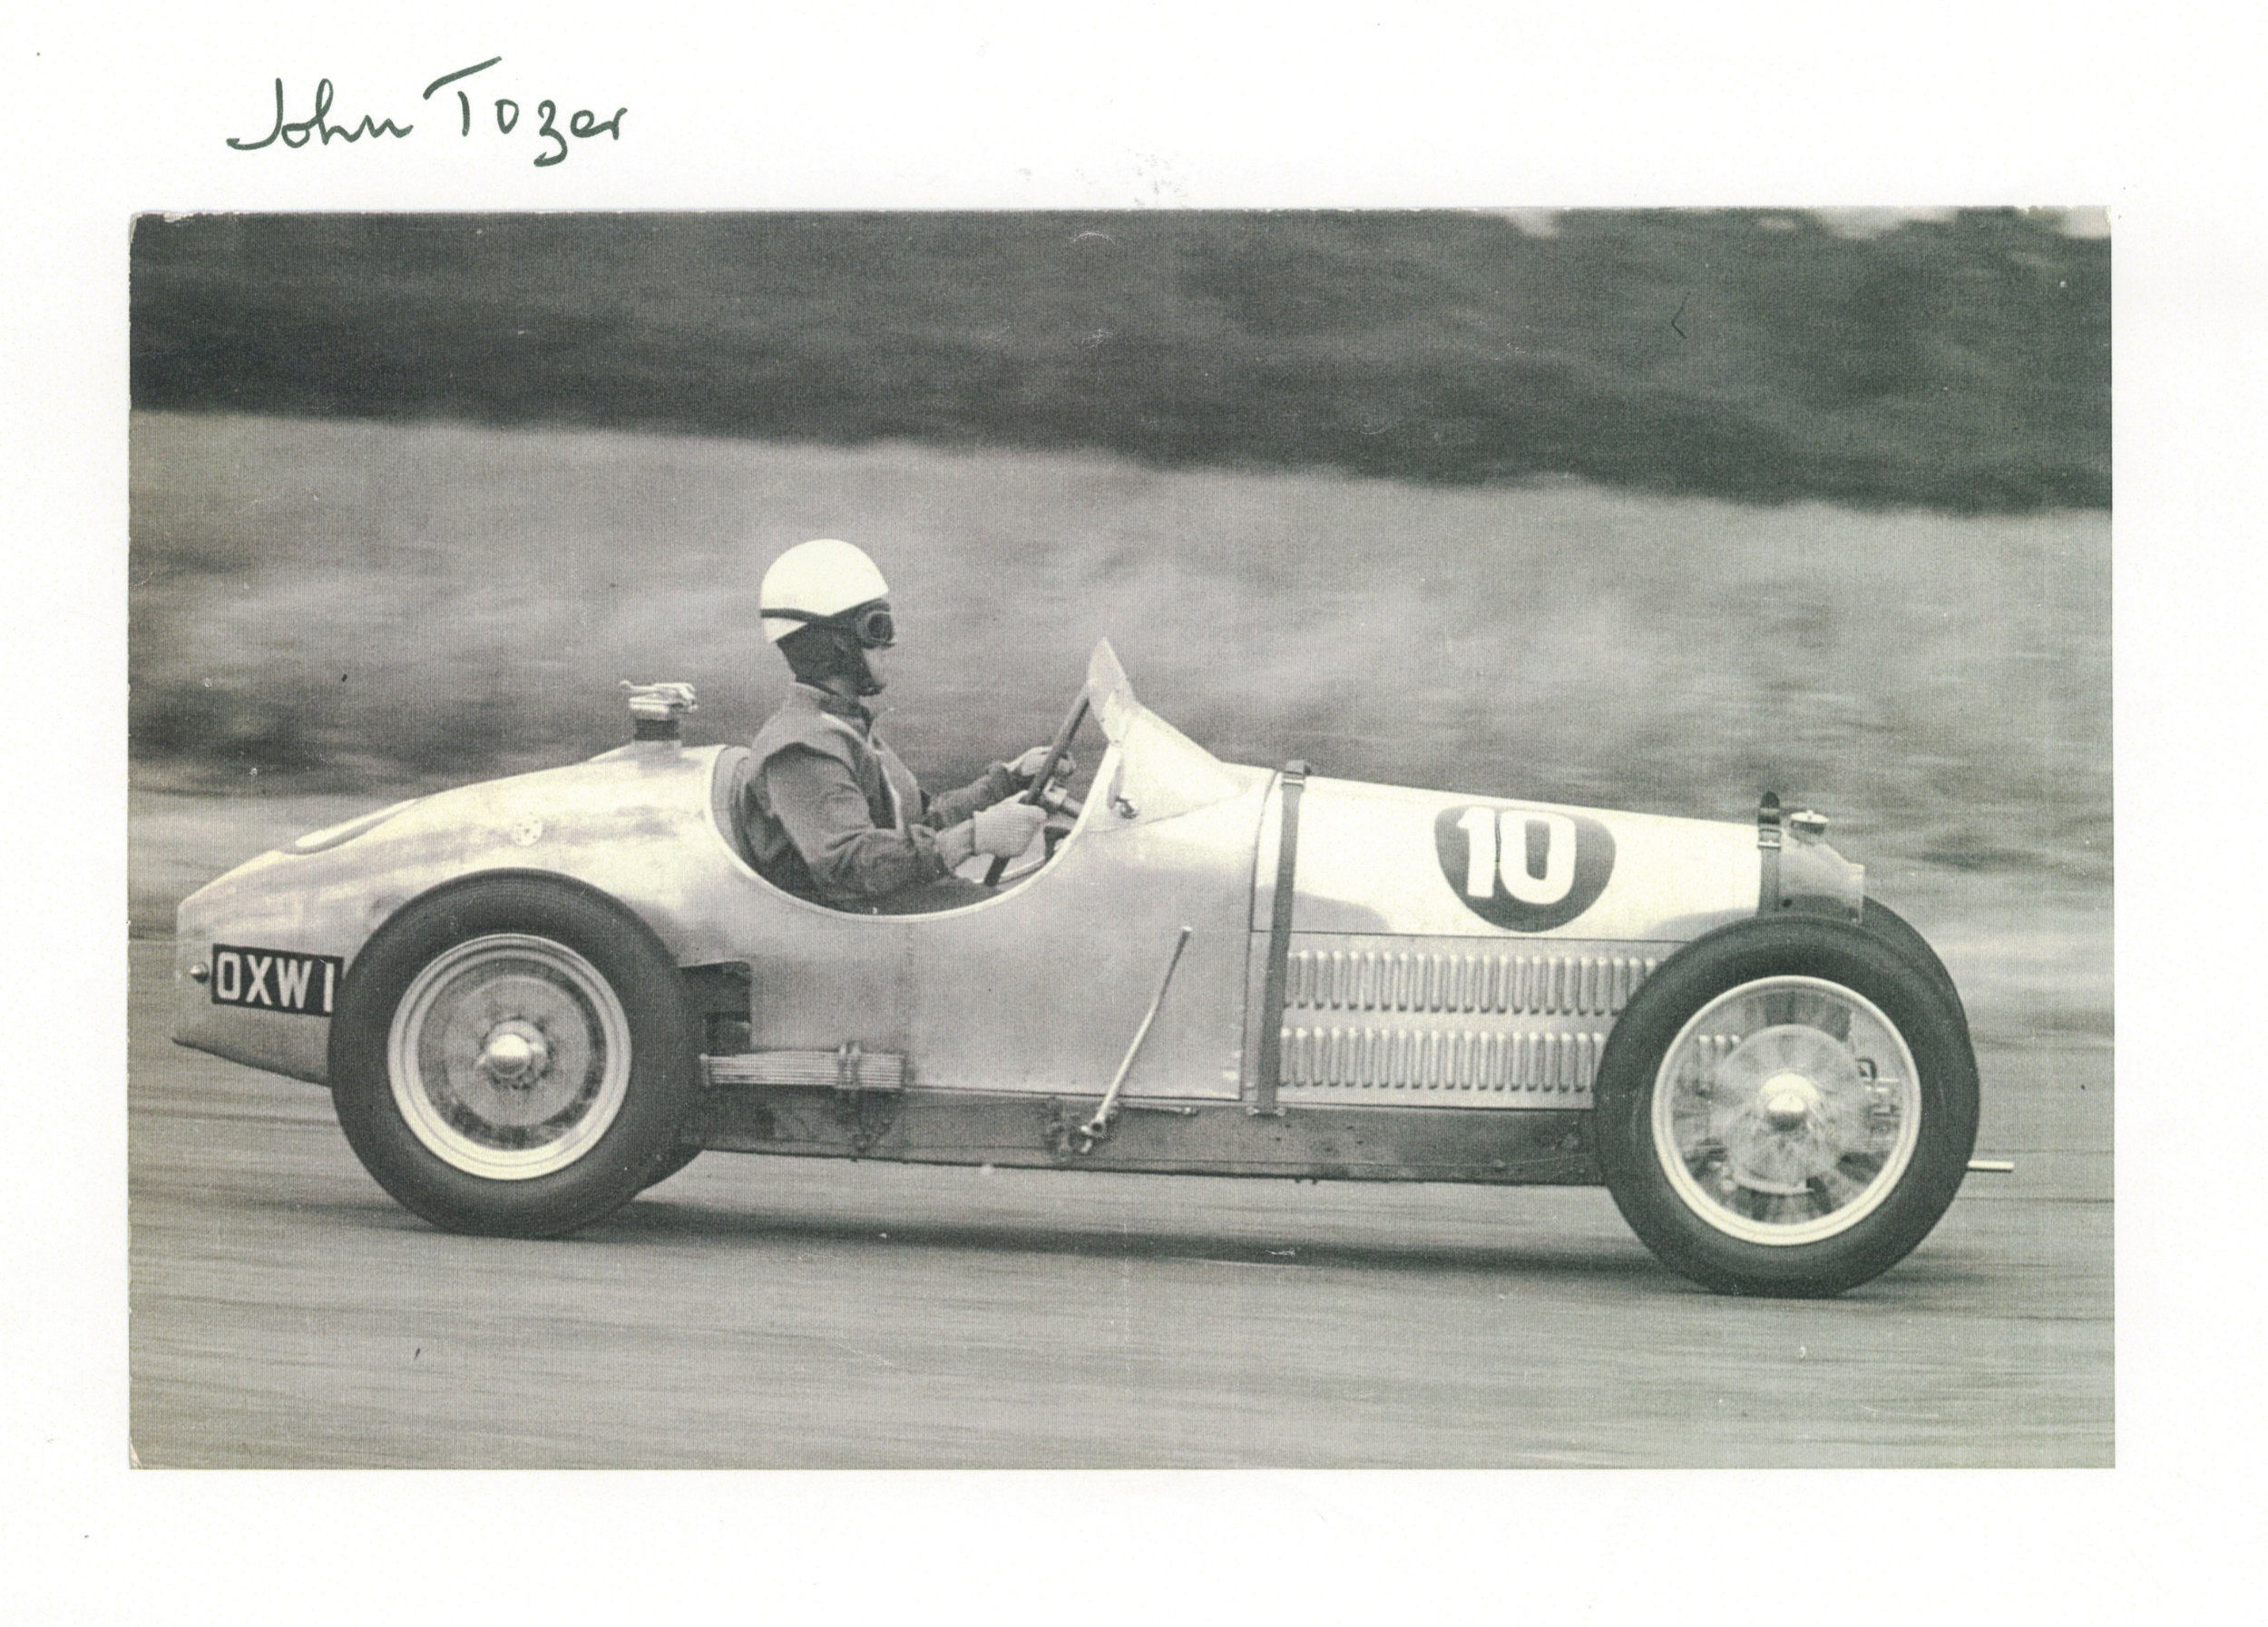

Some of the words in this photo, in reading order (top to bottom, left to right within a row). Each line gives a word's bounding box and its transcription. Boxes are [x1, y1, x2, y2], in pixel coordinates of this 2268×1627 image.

[226, 78, 414, 151] John
[423, 56, 628, 167] Tozer
[1457, 806, 1577, 905] 10
